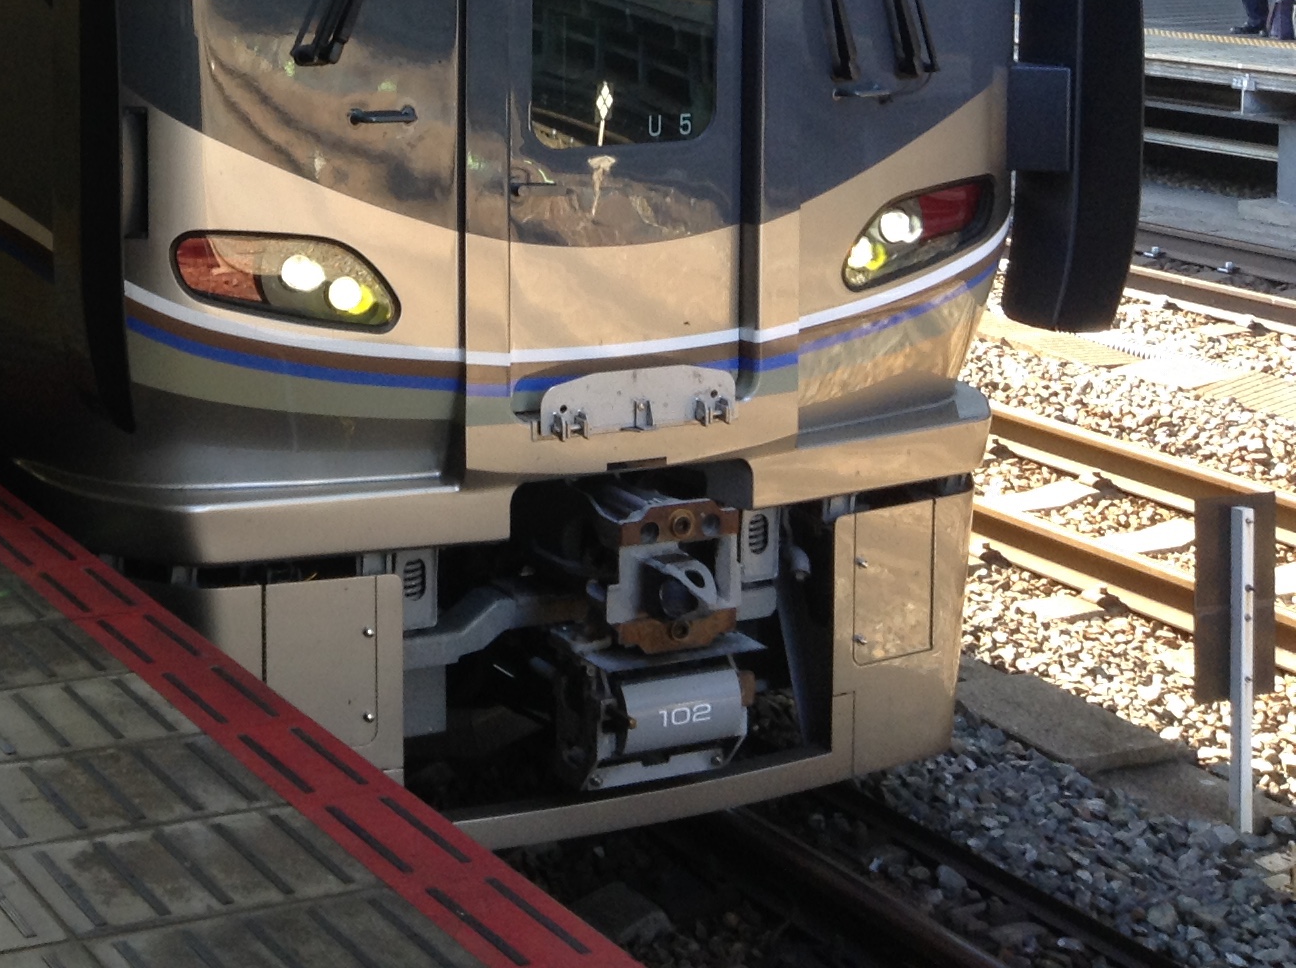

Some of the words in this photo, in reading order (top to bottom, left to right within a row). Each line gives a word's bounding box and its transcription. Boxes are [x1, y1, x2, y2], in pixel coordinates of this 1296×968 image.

[648, 114, 662, 137] U
[679, 113, 692, 135] 5
[659, 703, 712, 728] 102
